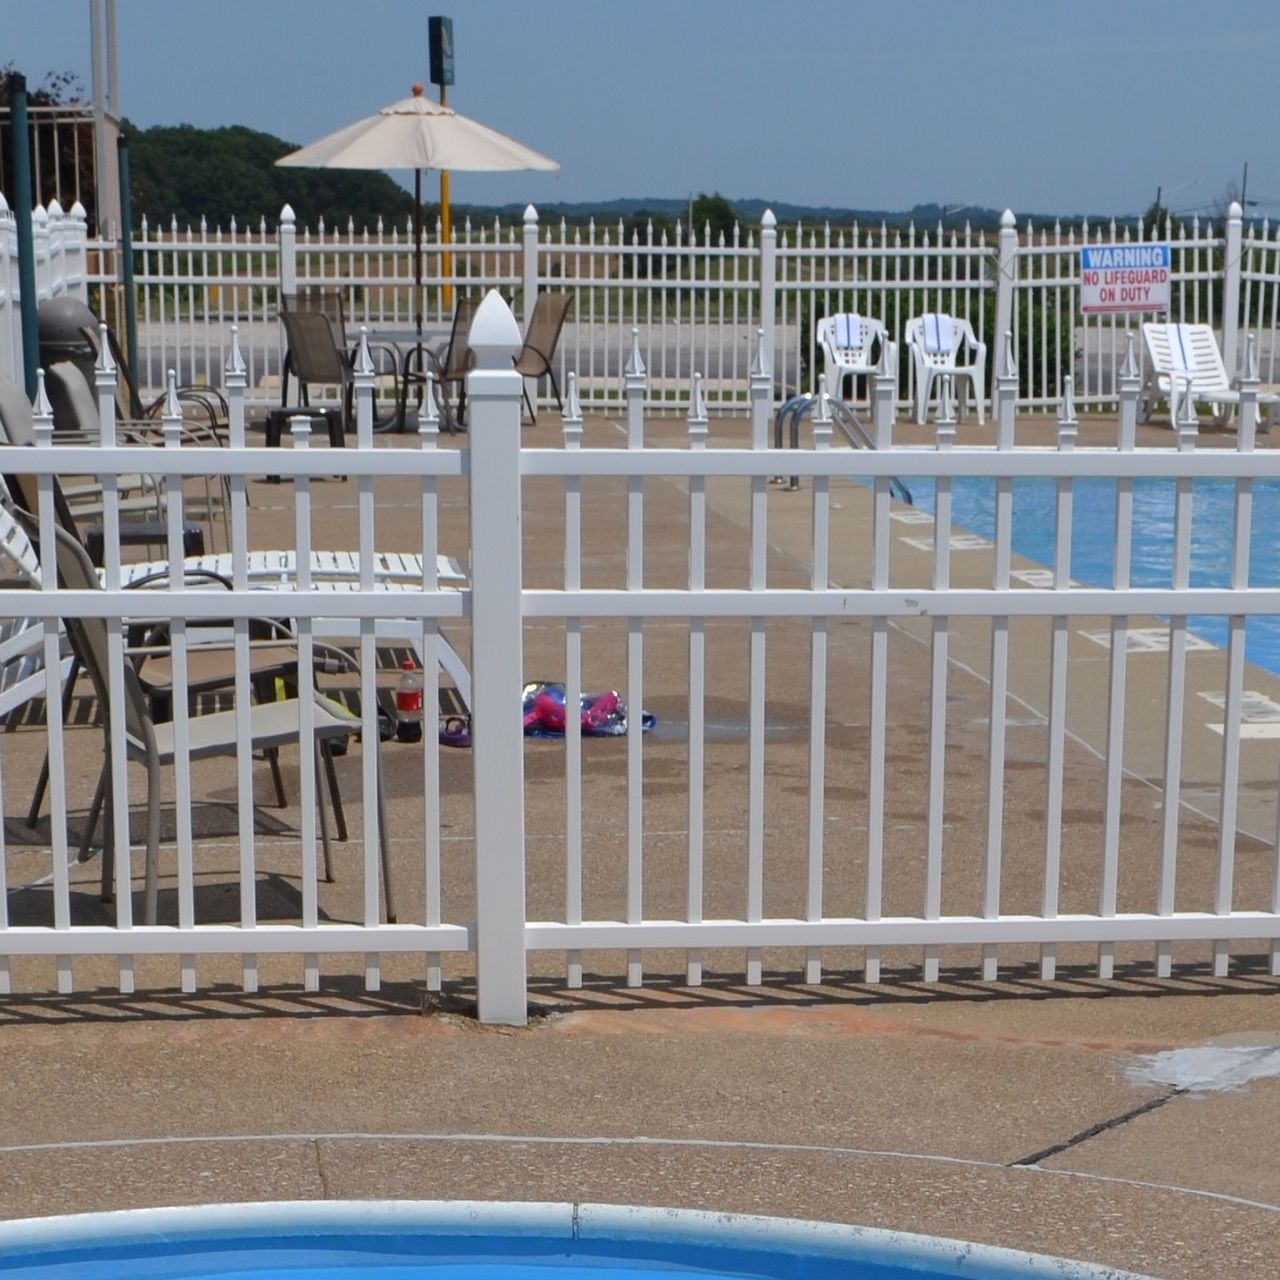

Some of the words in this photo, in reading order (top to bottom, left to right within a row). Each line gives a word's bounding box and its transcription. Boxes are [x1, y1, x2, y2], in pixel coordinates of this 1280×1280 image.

[1088, 247, 1163, 268] WARNING
[1083, 271, 1099, 285] NO
[1104, 269, 1167, 285] LIFEGUARD
[1100, 288, 1115, 302] ON
[1121, 287, 1150, 301] DUTY
